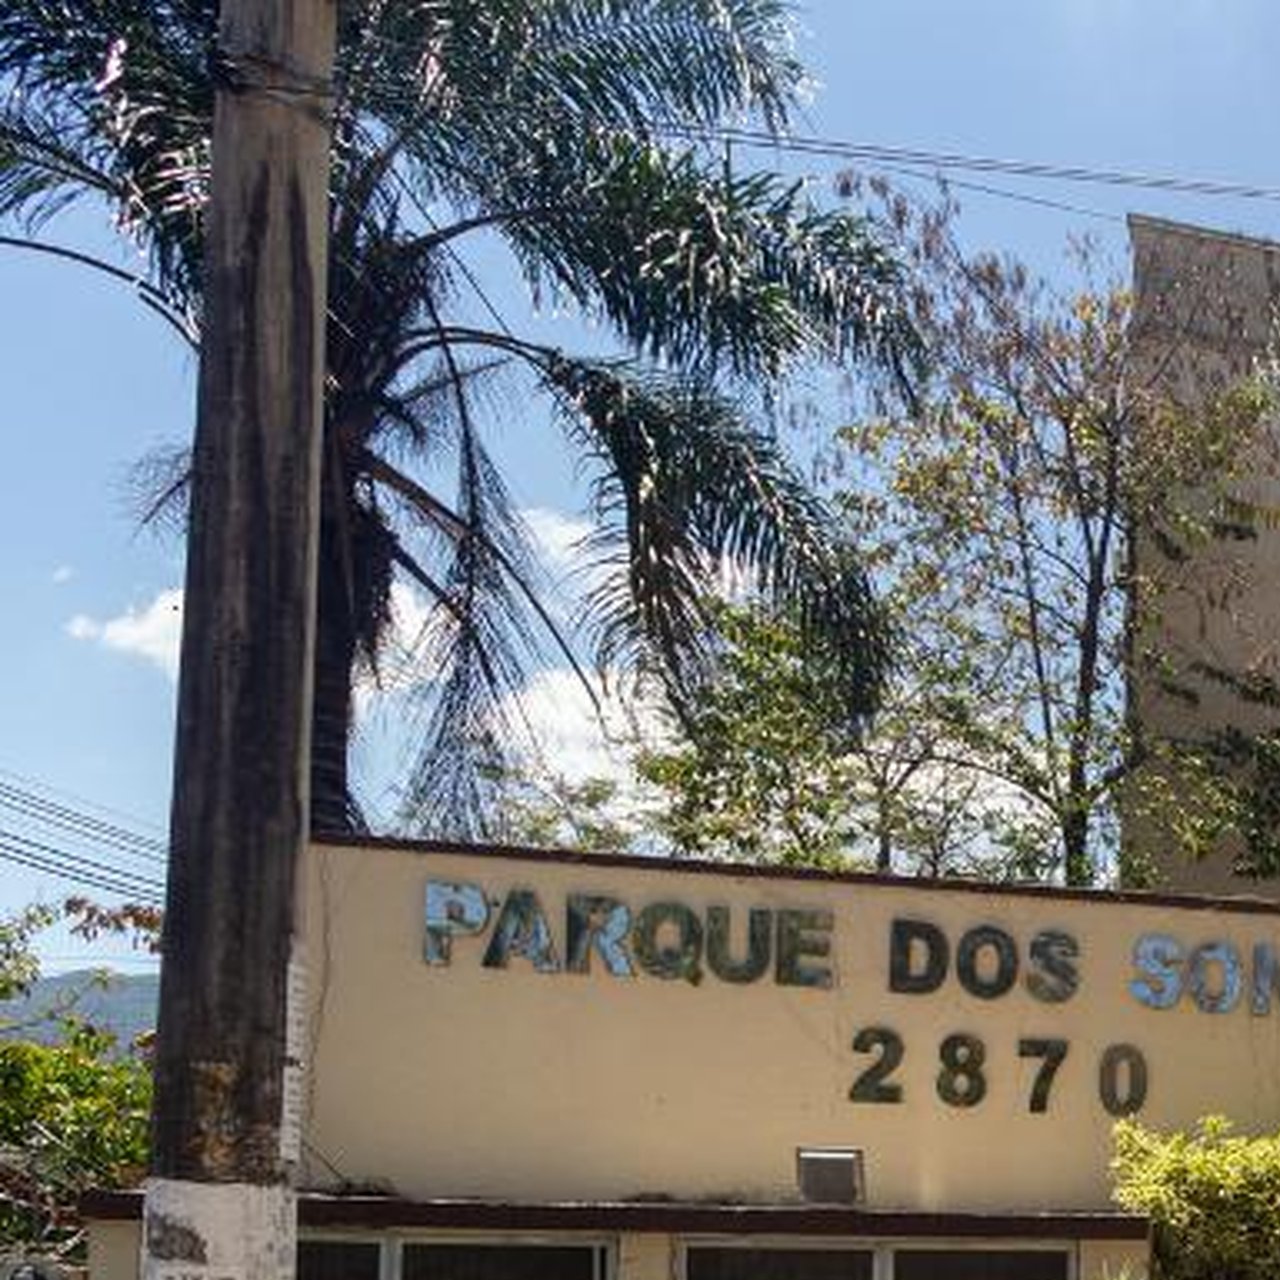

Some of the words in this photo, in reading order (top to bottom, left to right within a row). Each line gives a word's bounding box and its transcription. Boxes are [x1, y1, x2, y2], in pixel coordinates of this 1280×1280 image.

[425, 880, 835, 986] PARQUE
[889, 918, 1079, 1003] DOS
[848, 1027, 1148, 1116] 2870
